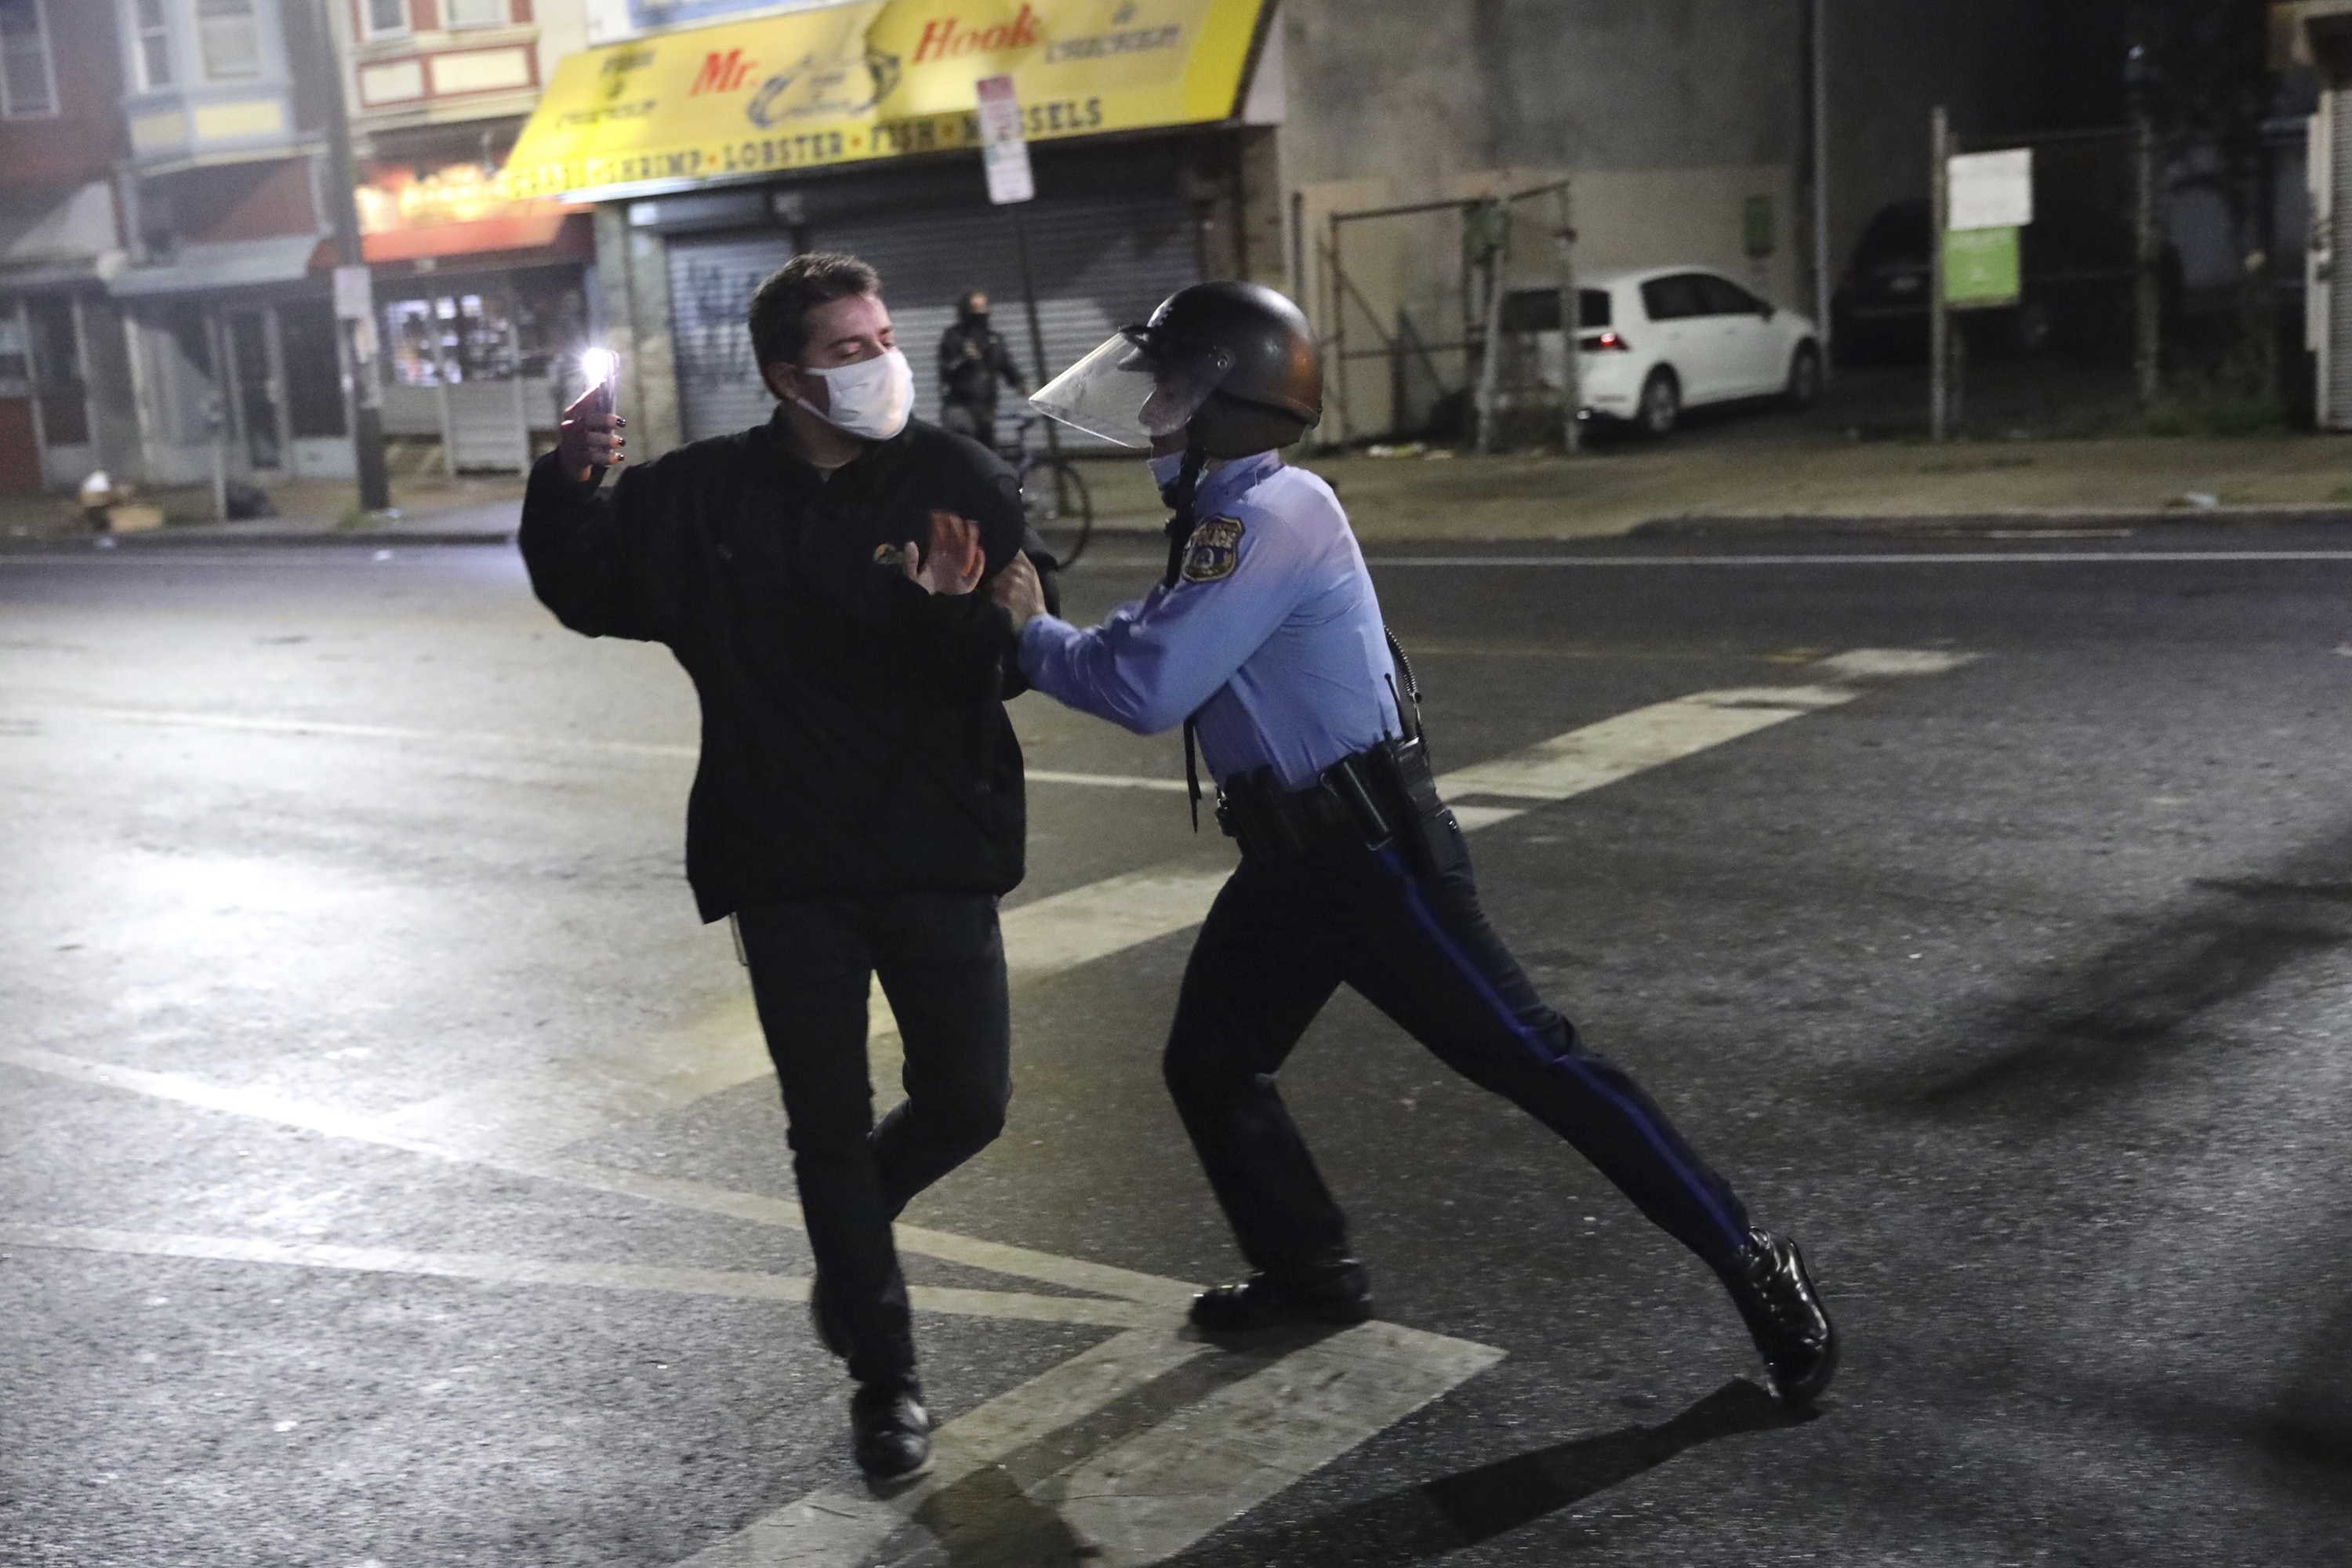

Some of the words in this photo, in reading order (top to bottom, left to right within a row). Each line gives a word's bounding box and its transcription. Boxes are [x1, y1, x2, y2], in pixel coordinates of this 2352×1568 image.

[906, 4, 1040, 65] Hook
[602, 149, 701, 183] SHRIMP
[723, 128, 842, 169] LOBSTER
